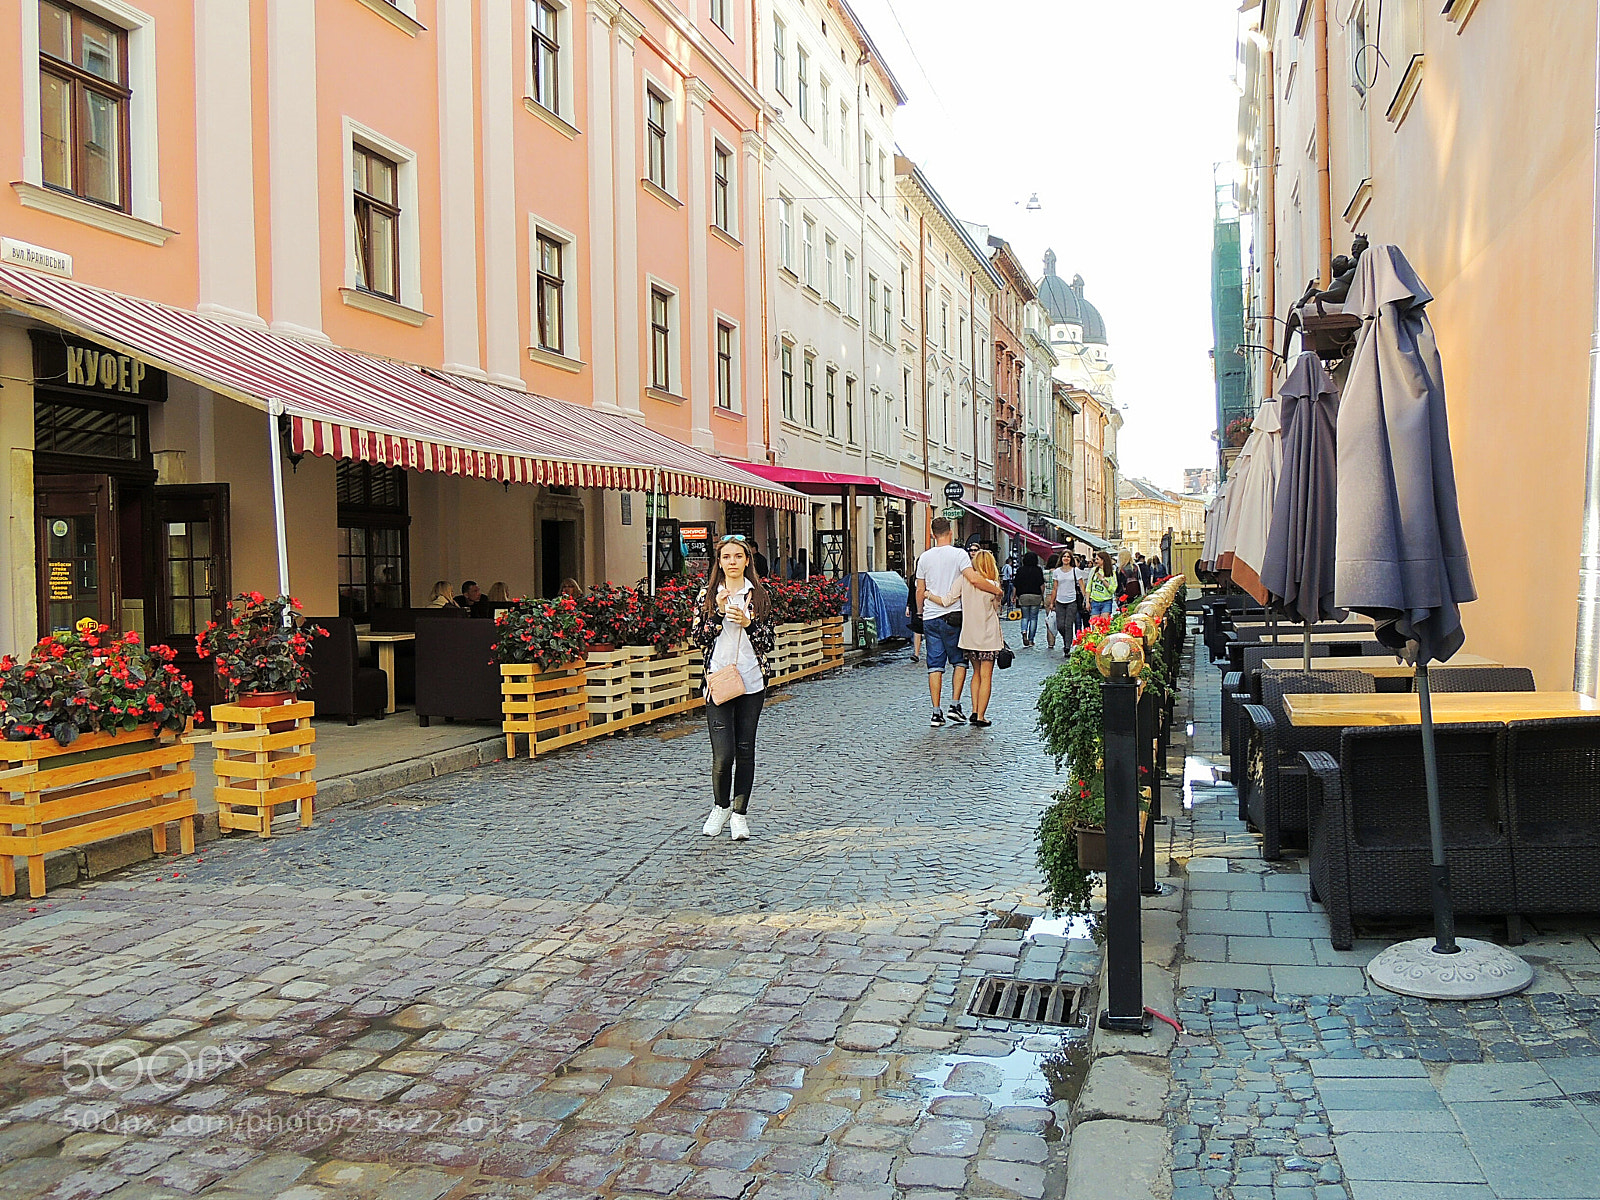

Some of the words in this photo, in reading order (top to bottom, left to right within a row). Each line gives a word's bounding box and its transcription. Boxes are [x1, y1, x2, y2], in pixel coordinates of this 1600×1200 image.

[67, 345, 146, 394] КУФЕР
[361, 437, 415, 464] КАФЕ
[439, 450, 497, 475] КУФЕР
[538, 465, 573, 482] CAFE
[942, 509, 965, 517] Hostel
